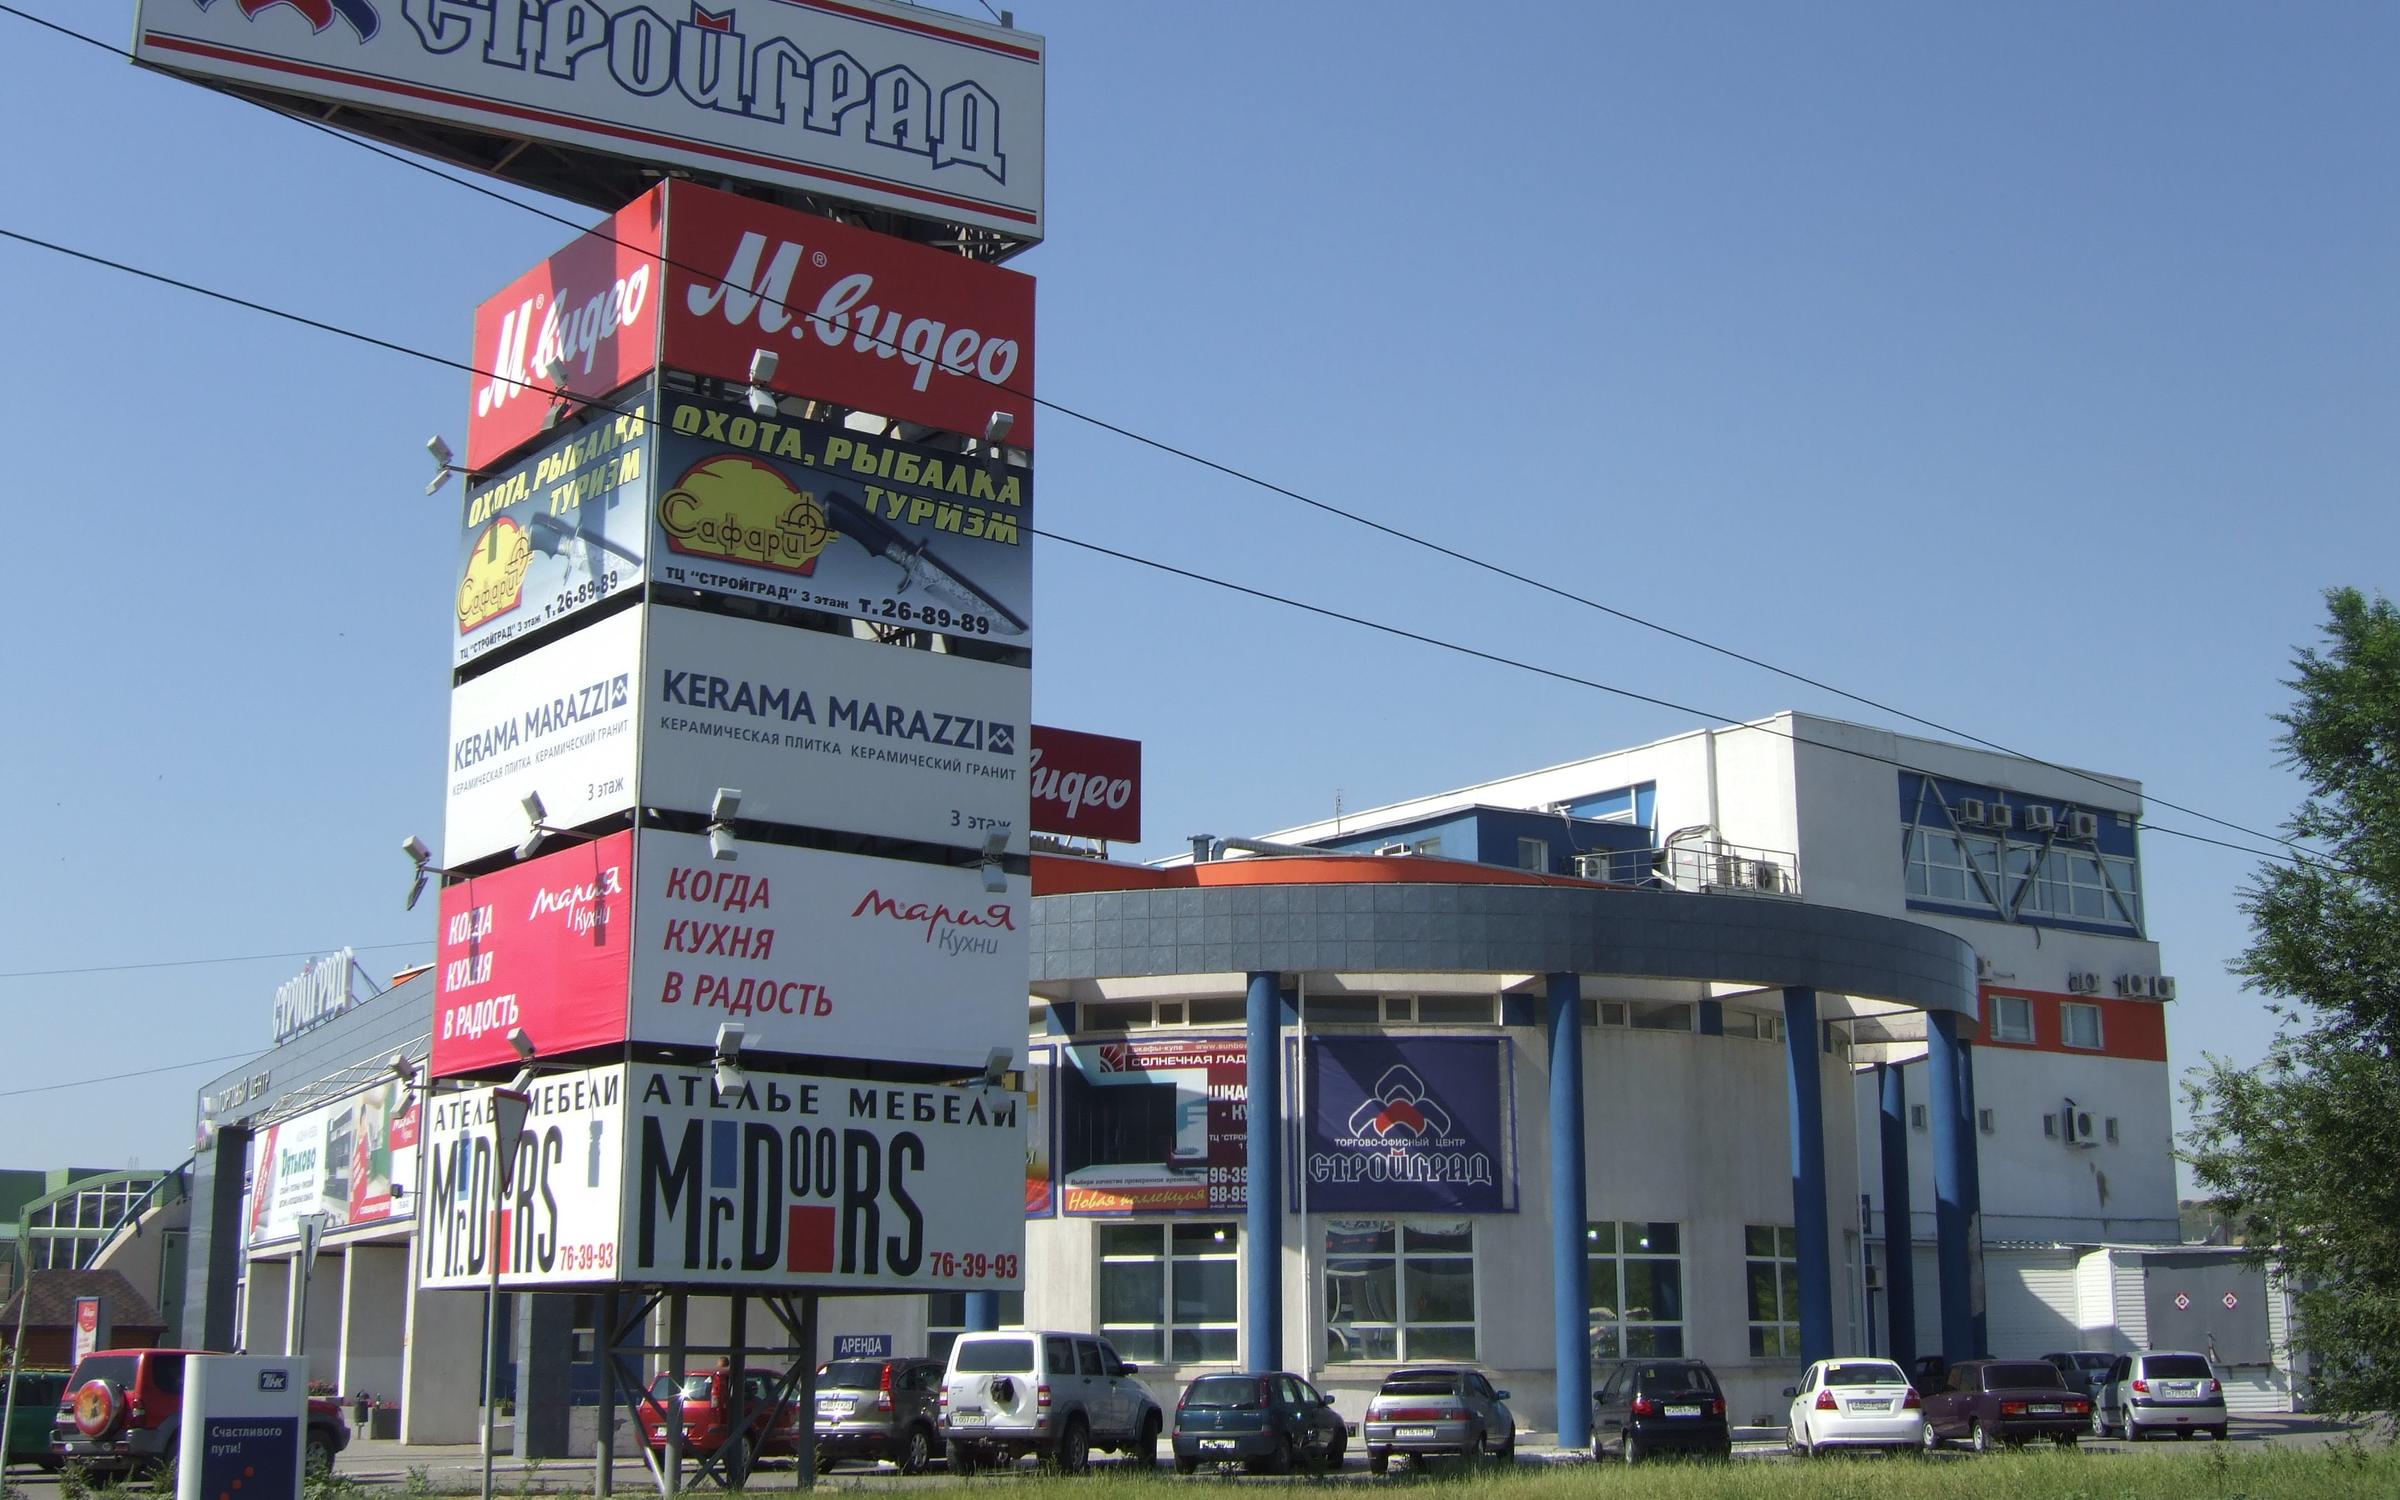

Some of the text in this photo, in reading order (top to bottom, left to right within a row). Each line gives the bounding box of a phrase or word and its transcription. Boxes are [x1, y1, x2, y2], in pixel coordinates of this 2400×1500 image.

[468, 405, 646, 528] ОХОТА, РЫБАЛКА
[671, 404, 1022, 507] ОХОТА, РЫБАЛКА
[550, 447, 641, 517] ТУРИЗМ
[658, 489, 834, 562] Сафари
[863, 485, 1020, 546] ТУРИЗМ
[458, 548, 528, 622] Сафари
[665, 566, 685, 583] ТЦ
[801, 590, 811, 603] 3
[813, 595, 850, 610] этаж
[454, 680, 610, 773] KERAMA MARAZZI
[663, 669, 984, 751] KERAMA MARAZZI
[453, 719, 629, 796] КЕРАМИЧЕСКАЯ ПЛИТКА КЕРАМИЧЕСКИЙ ГРАНИТ
[660, 716, 1017, 782] КЕРАМИЧЕСКАЯ ПЛИТКА КЕРАМИЧЕСКИЙ ГРАНИТ
[588, 777, 624, 801] 3 этаж
[951, 809, 961, 827] 3
[666, 867, 771, 914] КОГДА
[574, 906, 611, 936] Кухни
[663, 918, 775, 961] КУХНЯ
[938, 927, 1000, 957] Кухни
[445, 951, 494, 993] КУХНЯ
[661, 971, 833, 1017] В РАДОСТЬ
[443, 993, 519, 1041] В РАДОСТЬ
[1132, 1053, 1247, 1067] СОЛНЕЧНАЯ ЛАД
[642, 1073, 1017, 1128] АТЕЛЬЕ МЕБЕЛИ
[1208, 1085, 1247, 1101] ШКА
[434, 1096, 497, 1133] АТЕЛЬ
[1334, 1136, 1466, 1148] ТОРГОВО-ОФИСНЫЙ ЦЕНТР
[1308, 1147, 1493, 1187] СТРОЙГРАД
[1069, 1188, 1115, 1211] Новая
[560, 1242, 614, 1272] 76-39-93
[930, 1251, 1019, 1280] 76-39-93
[840, 1336, 882, 1354] АРЕНДА
[211, 1425, 283, 1438] Счастливого
[211, 1442, 242, 1455] пути!
